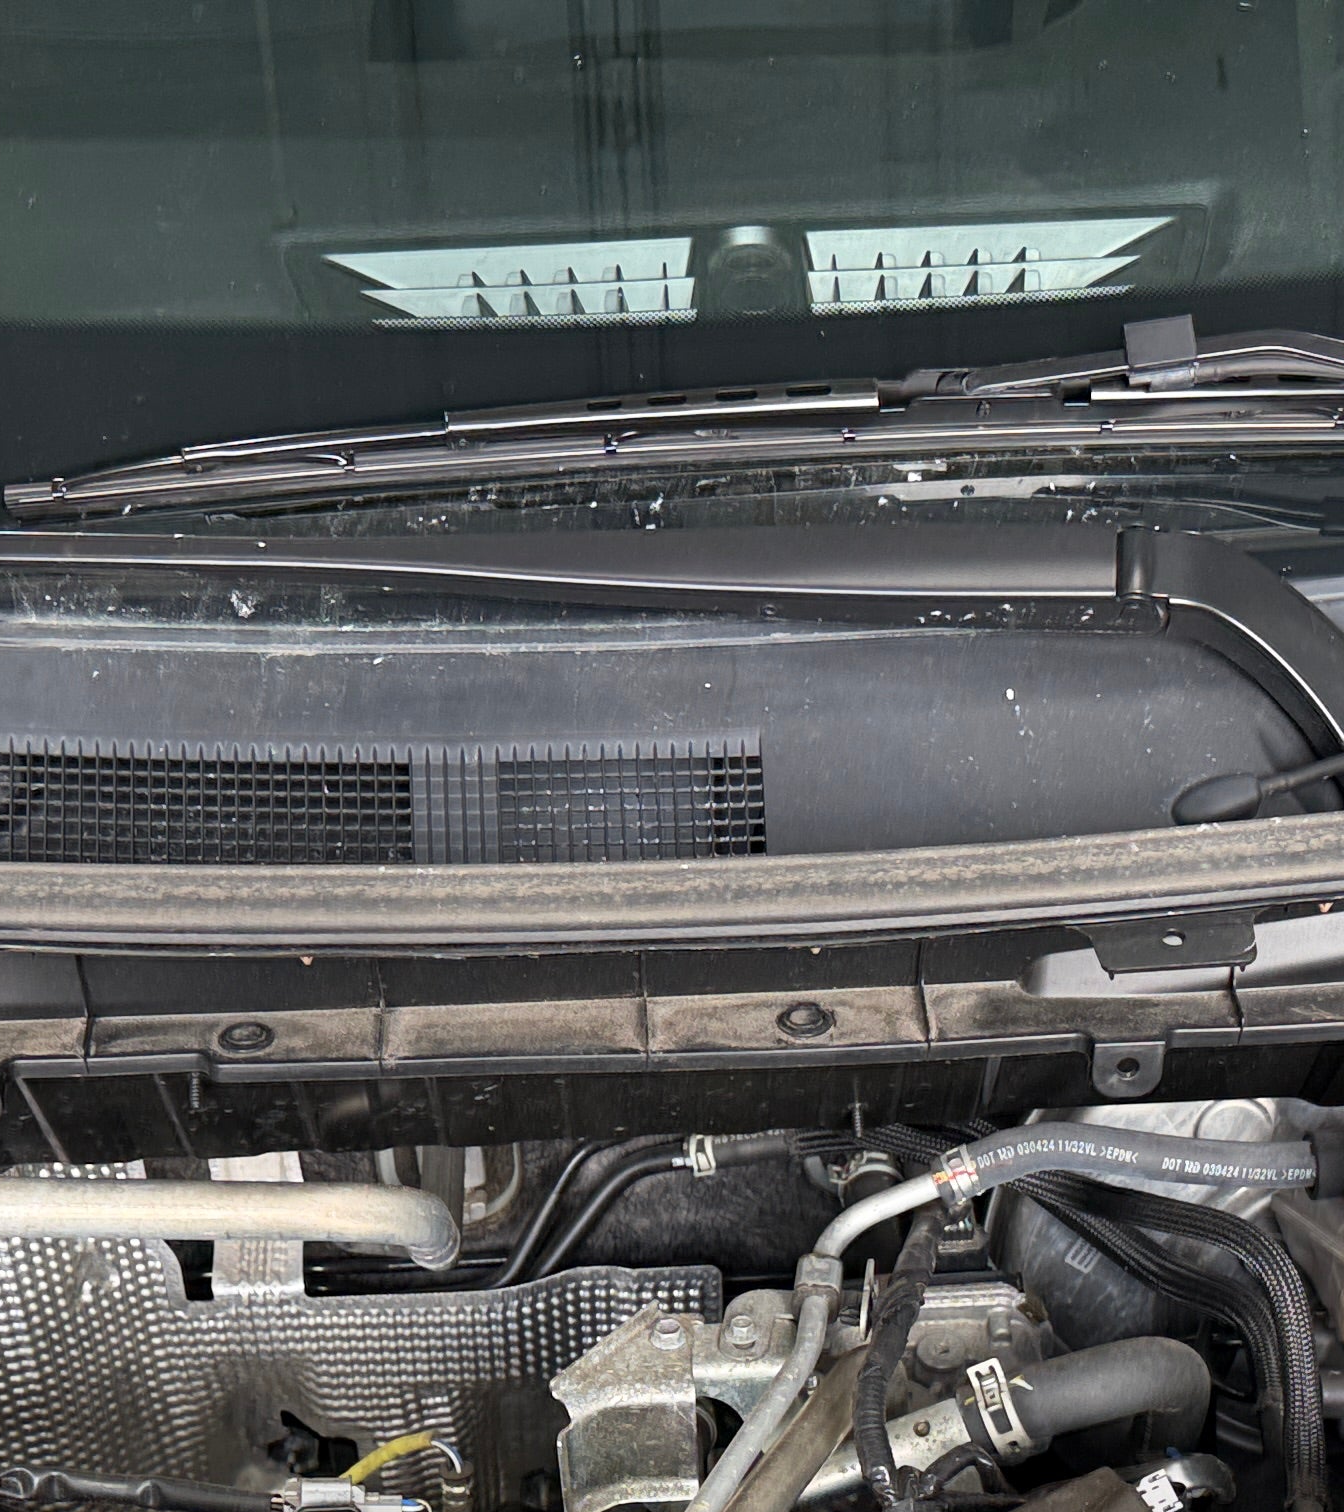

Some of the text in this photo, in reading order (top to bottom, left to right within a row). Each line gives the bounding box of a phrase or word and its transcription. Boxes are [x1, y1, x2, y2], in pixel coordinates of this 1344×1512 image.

[977, 1152, 996, 1169] DOT
[1016, 1139, 1055, 1156] 030424
[1161, 1156, 1183, 1172] DOT
[1203, 1163, 1240, 1178] 030424
